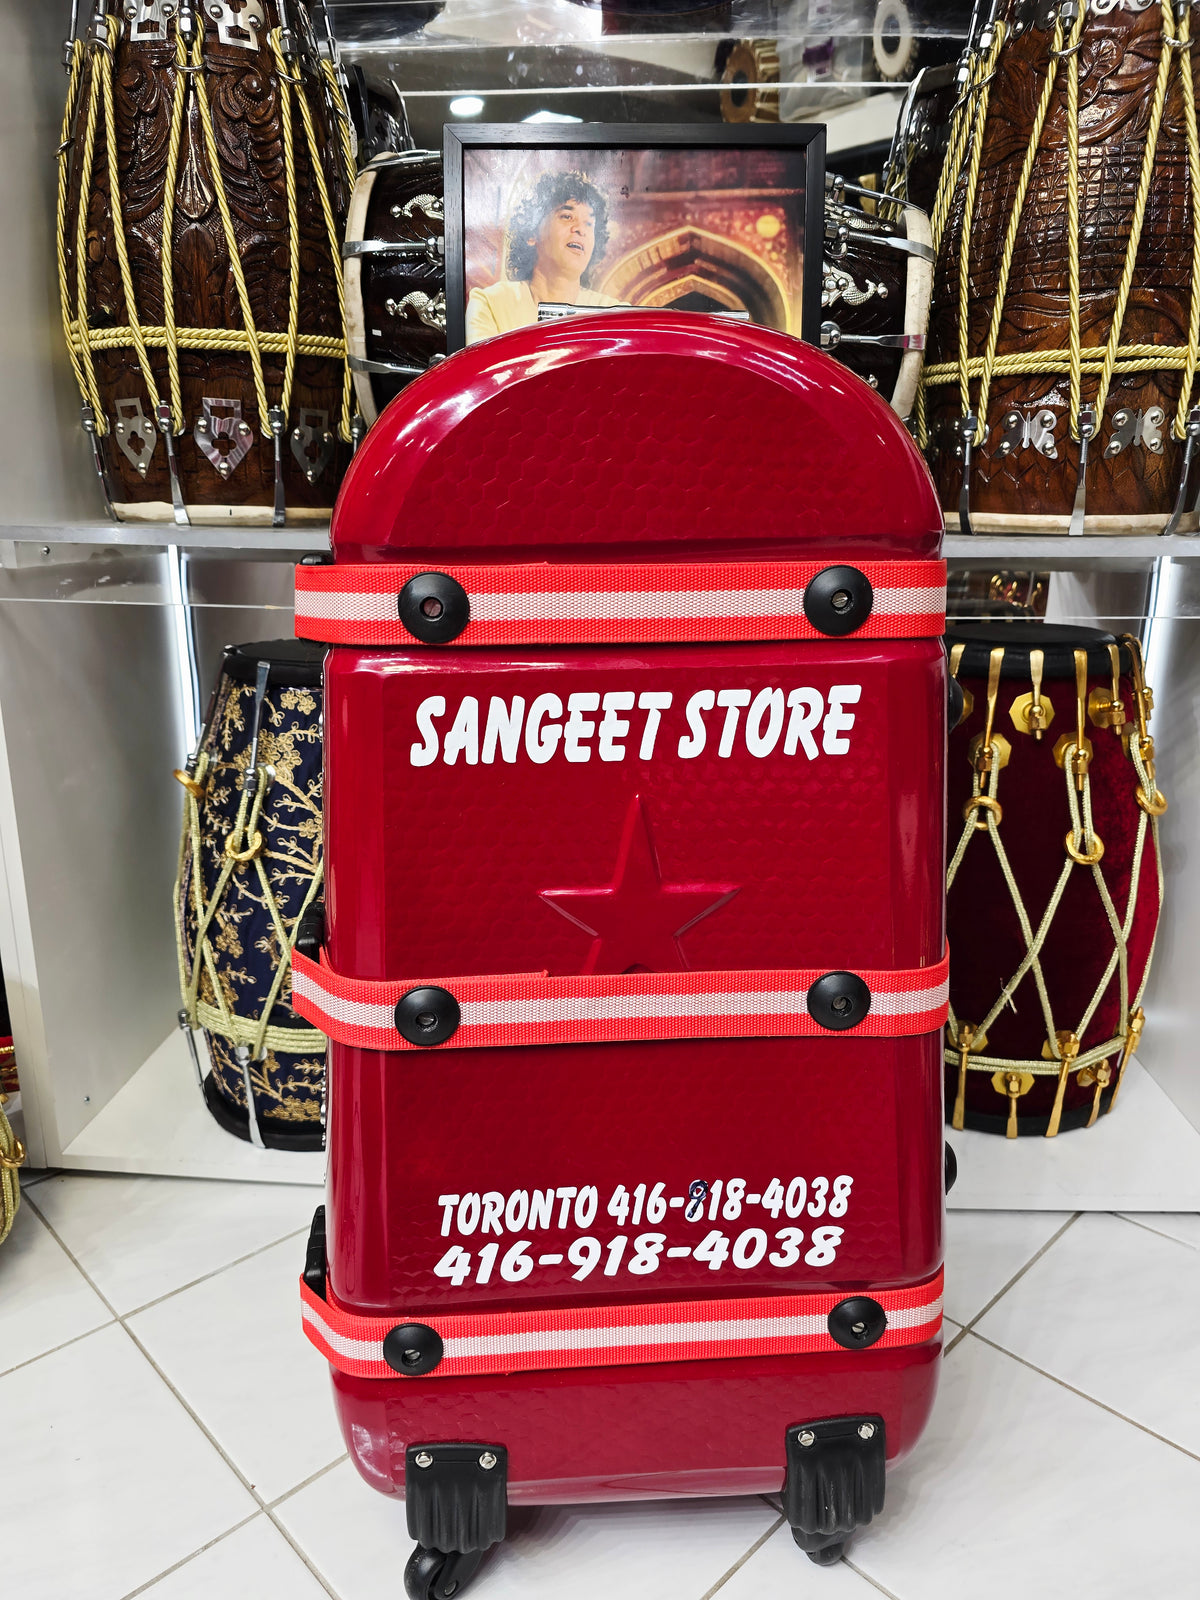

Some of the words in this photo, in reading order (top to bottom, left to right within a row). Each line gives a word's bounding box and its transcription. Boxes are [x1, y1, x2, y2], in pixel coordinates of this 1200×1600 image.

[409, 691, 673, 767] SANGEET
[677, 684, 862, 760] STORE
[437, 1185, 599, 1237] TORONTO
[433, 1225, 845, 1287] 416-918-4038
